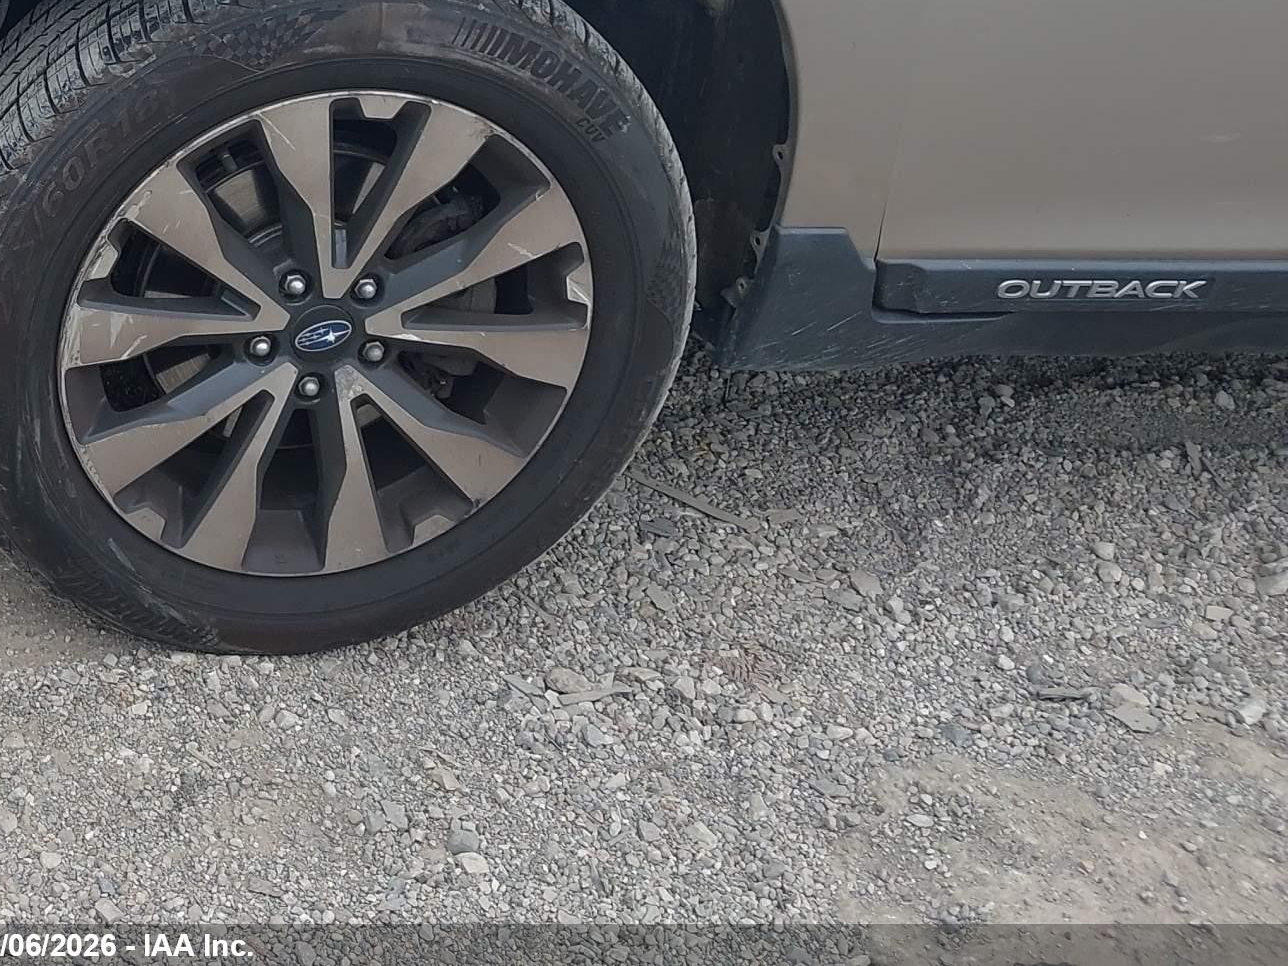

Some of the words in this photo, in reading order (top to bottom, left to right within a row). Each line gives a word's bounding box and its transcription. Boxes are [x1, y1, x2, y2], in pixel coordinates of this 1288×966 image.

[498, 27, 630, 134] MOHAVE
[575, 117, 608, 143] CUV
[997, 279, 1207, 299] OUTBACK
